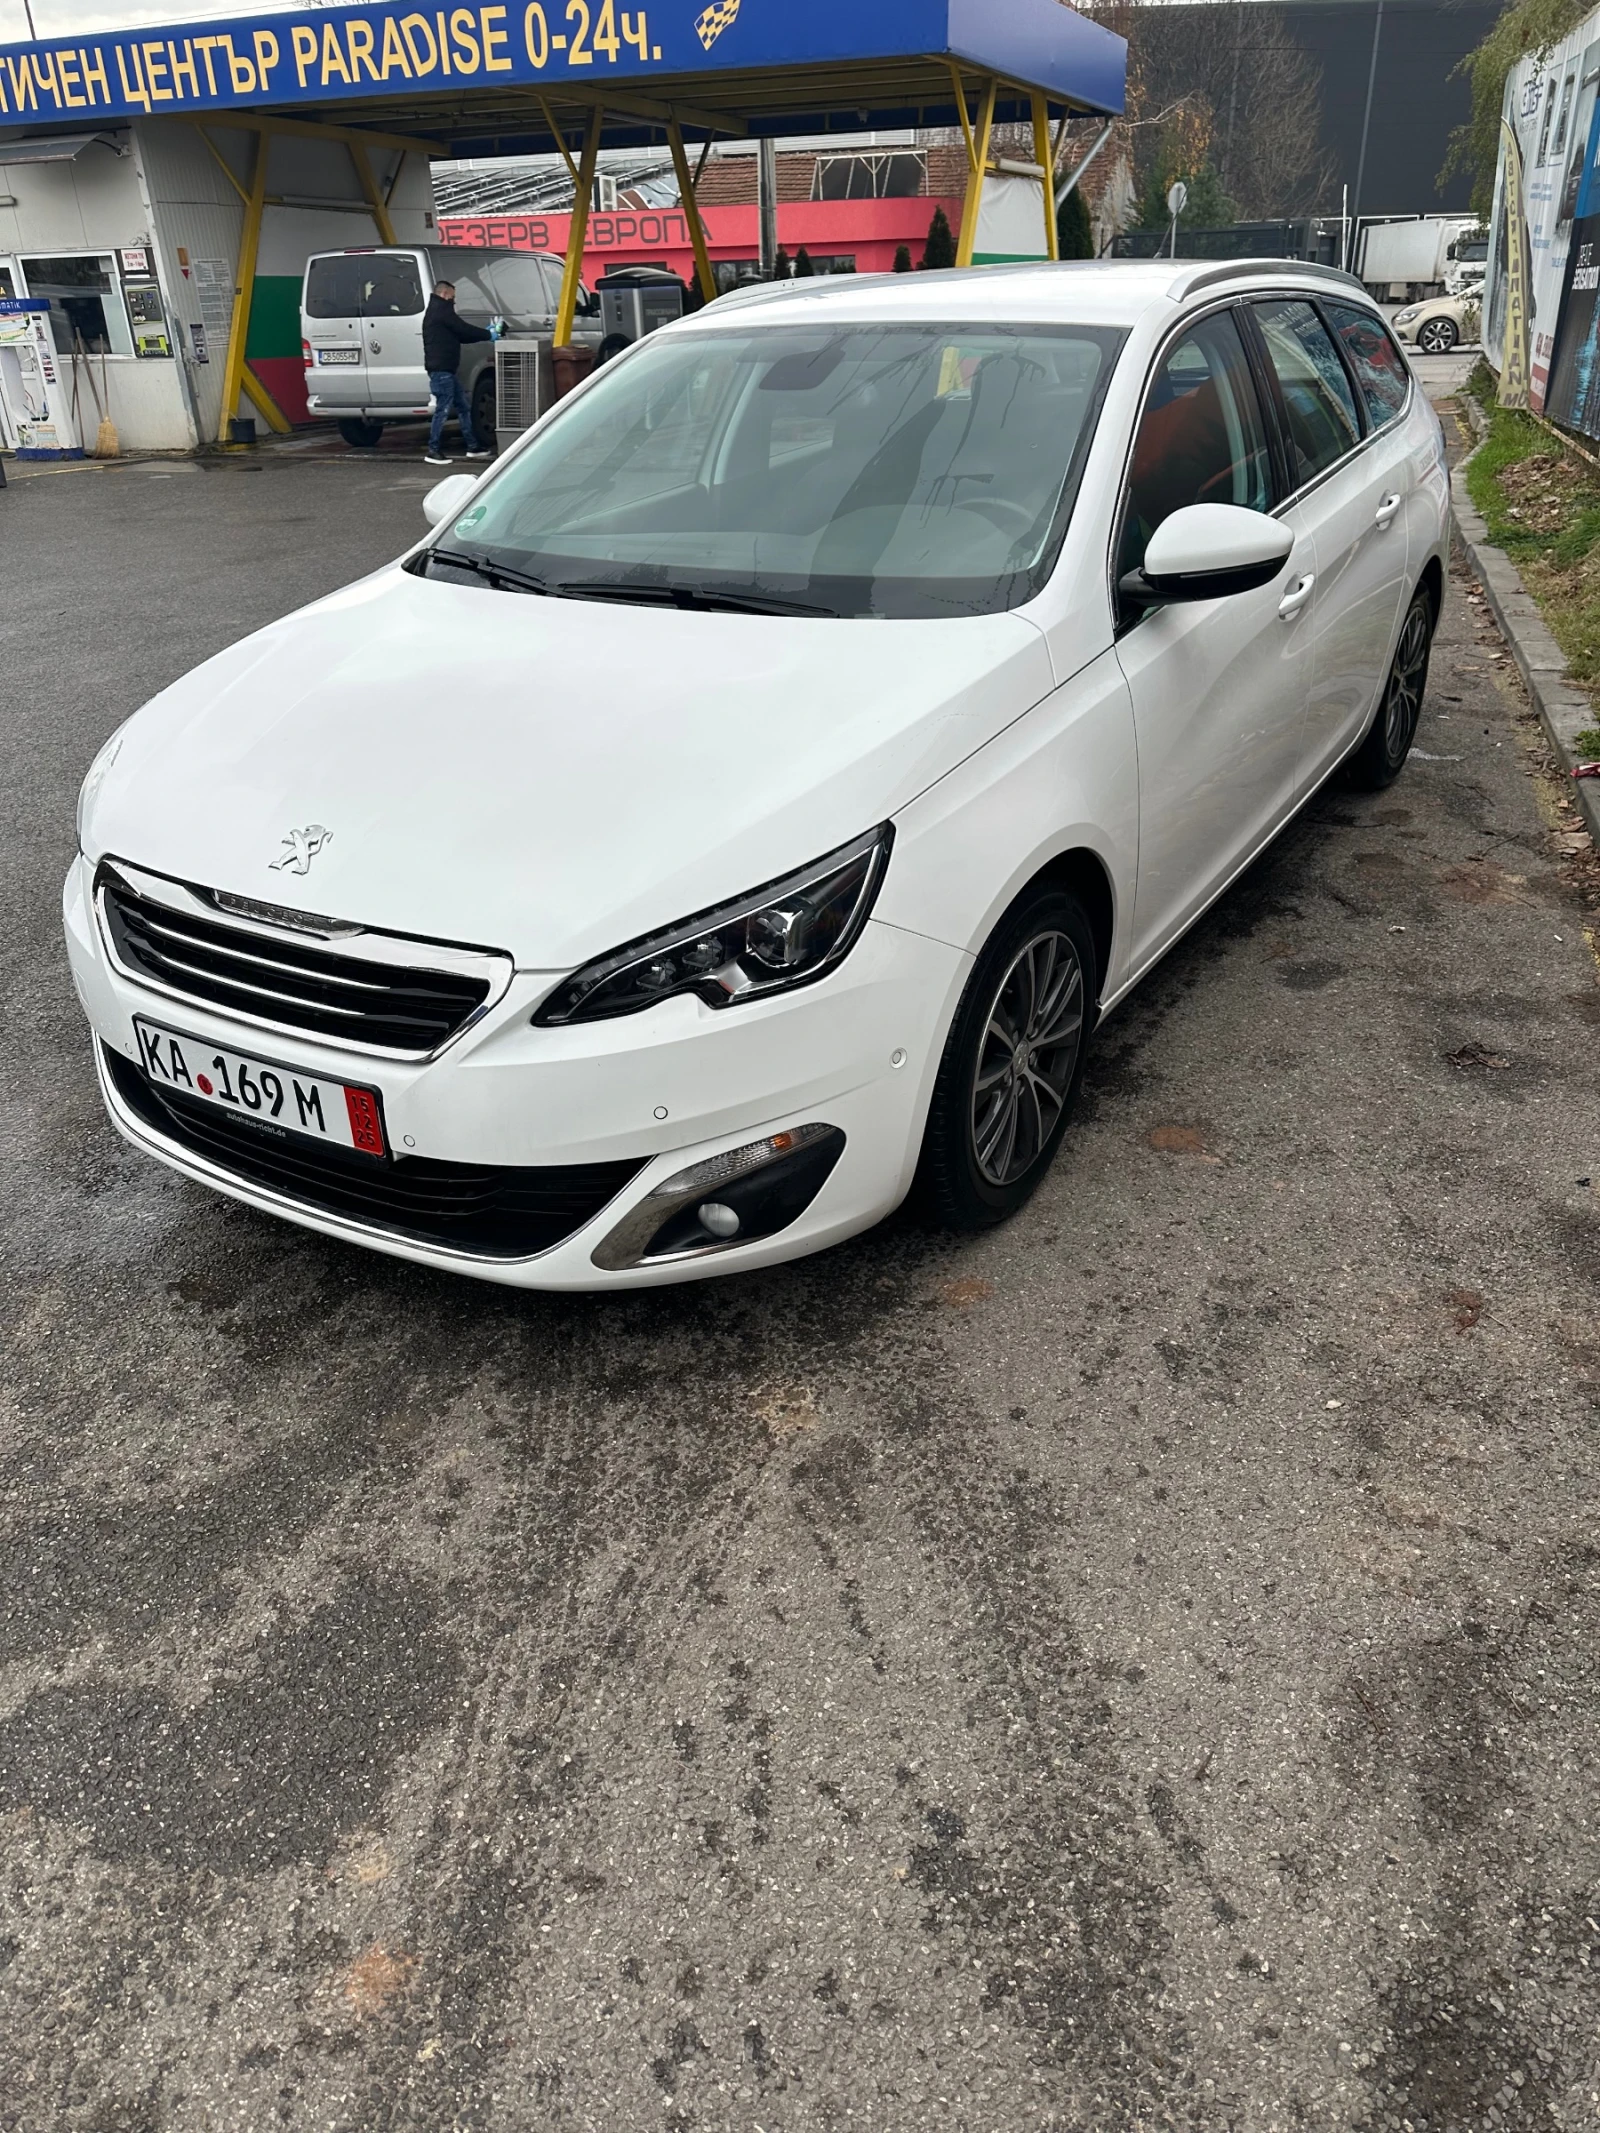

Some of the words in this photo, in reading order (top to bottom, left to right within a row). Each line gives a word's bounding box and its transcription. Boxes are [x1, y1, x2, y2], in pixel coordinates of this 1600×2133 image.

[115, 29, 280, 113] ЦЕНТЪР
[291, 5, 512, 88] PARADISE
[141, 1027, 194, 1088] KA
[212, 1055, 284, 1118] 169
[292, 1079, 327, 1133] M
[351, 1095, 369, 1113] 15
[355, 1113, 373, 1130] 12
[356, 1130, 376, 1147] 25
